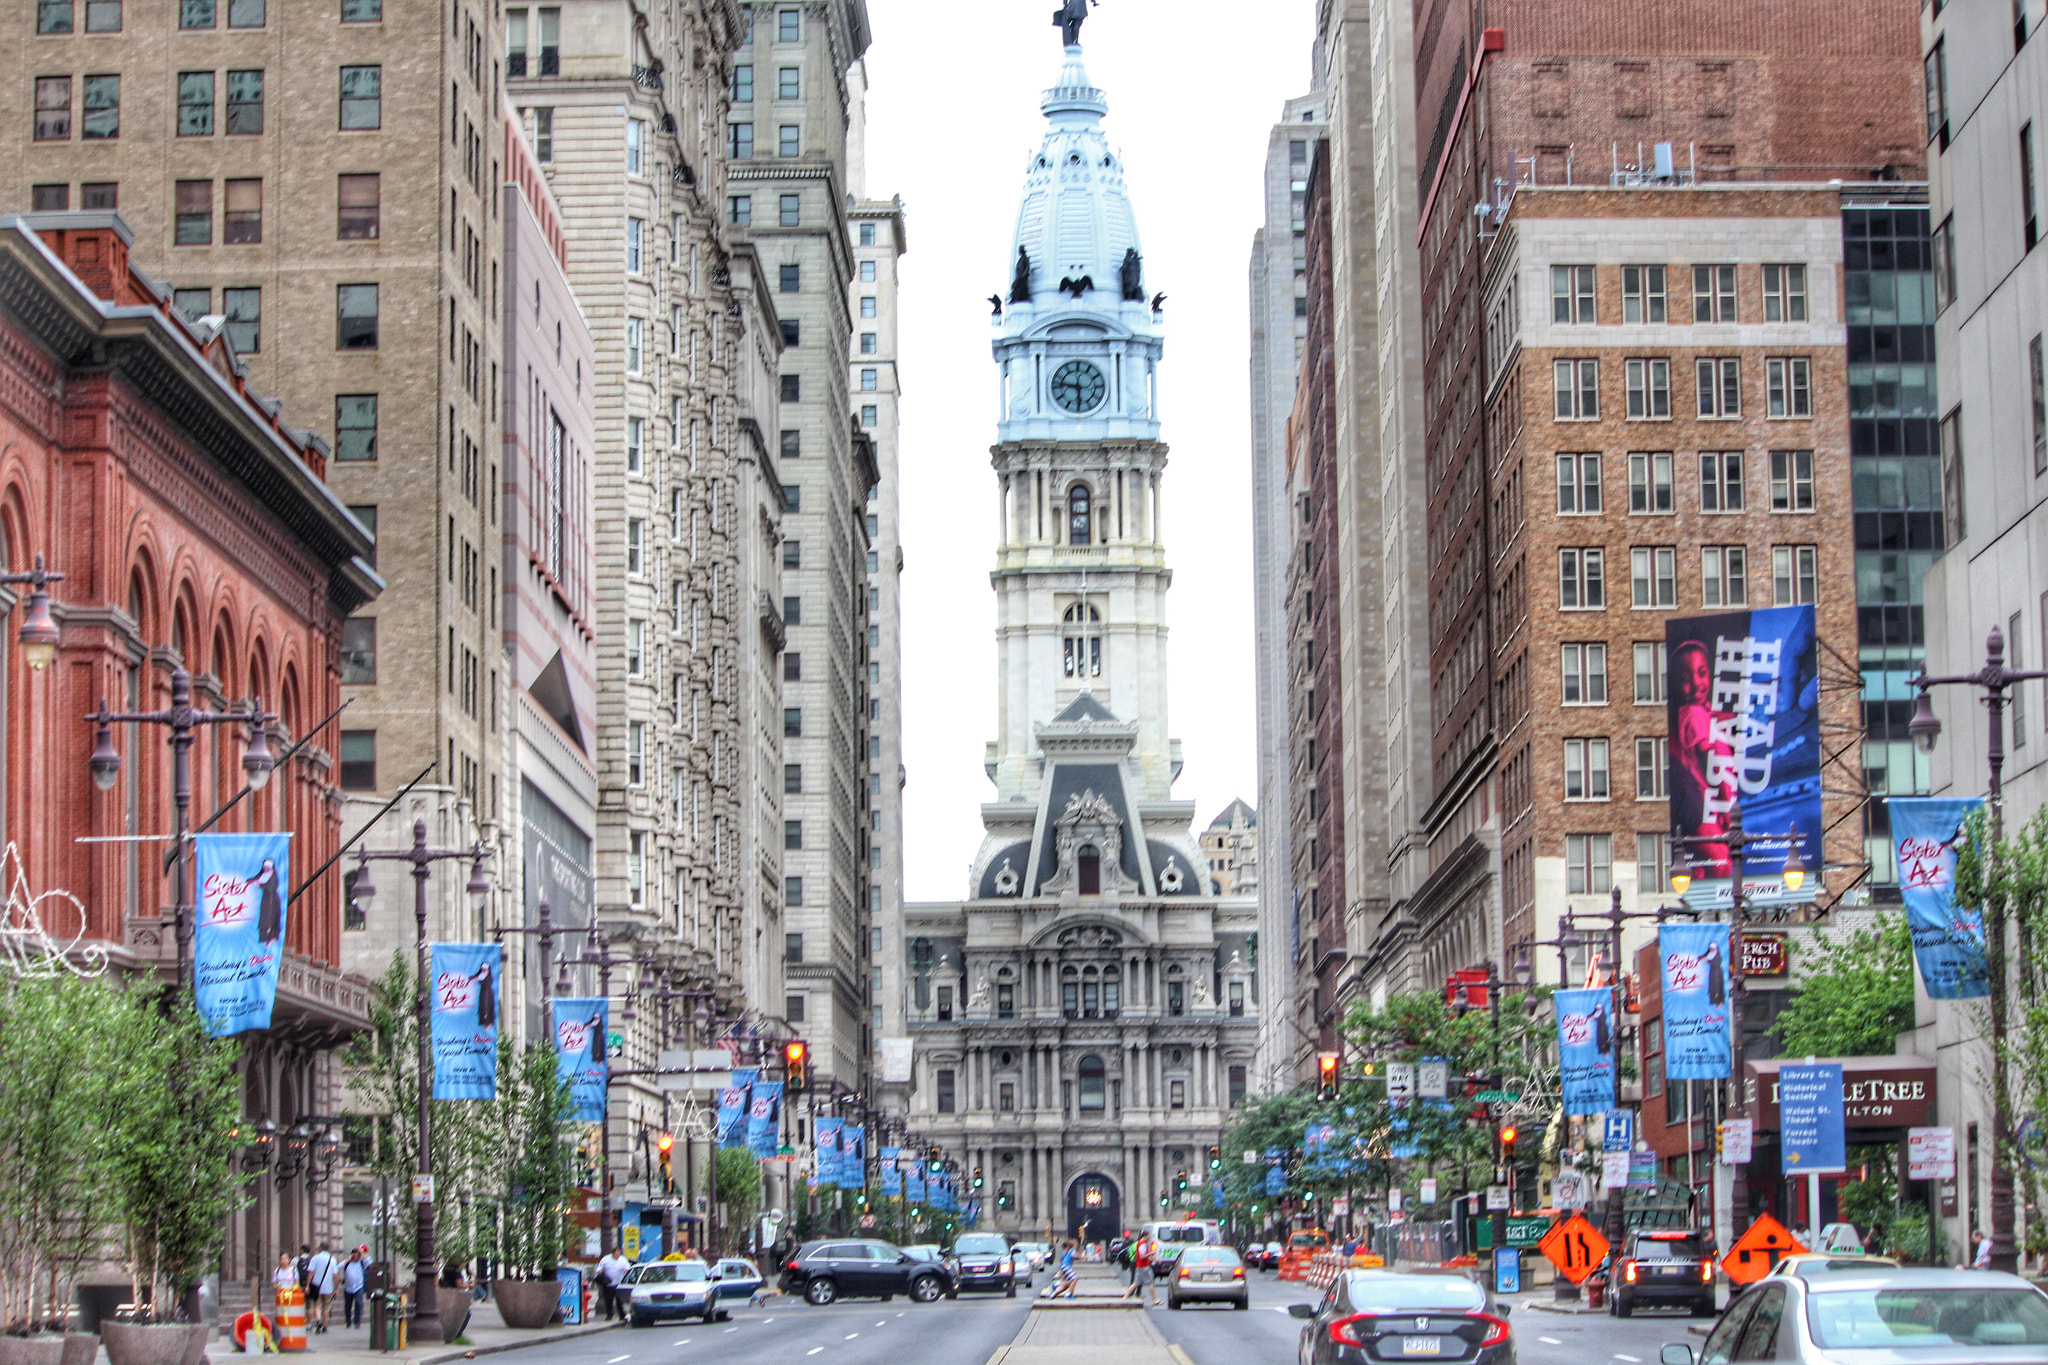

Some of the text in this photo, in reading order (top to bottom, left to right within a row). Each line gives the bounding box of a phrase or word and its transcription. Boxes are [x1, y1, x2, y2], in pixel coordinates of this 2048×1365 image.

[1738, 636, 1782, 795] HEAD
[1702, 634, 1750, 824] HEART
[1900, 836, 1946, 864] Sister
[1907, 859, 1943, 886] Act
[204, 873, 254, 898] Sister
[1718, 886, 1779, 897] INSTATE
[210, 896, 248, 923] Act
[1741, 942, 1778, 955] ERCH
[1667, 953, 1703, 972] Sister
[1741, 955, 1771, 969] PUB
[437, 972, 475, 992] Sister
[1673, 970, 1698, 989] Act
[442, 989, 468, 1009] Act
[1392, 1065, 1407, 1073] ONE
[1783, 1070, 1833, 1080] Library Co.
[1784, 1083, 1827, 1092] Historical
[1785, 1093, 1817, 1101] Society
[1785, 1106, 1831, 1116] Walnut St.
[1846, 1105, 1893, 1117] ILTON
[1786, 1116, 1818, 1124] Theatre
[1609, 1119, 1627, 1138] H
[1786, 1129, 1817, 1138] Forrest
[1787, 1137, 1818, 1146] Theatre
